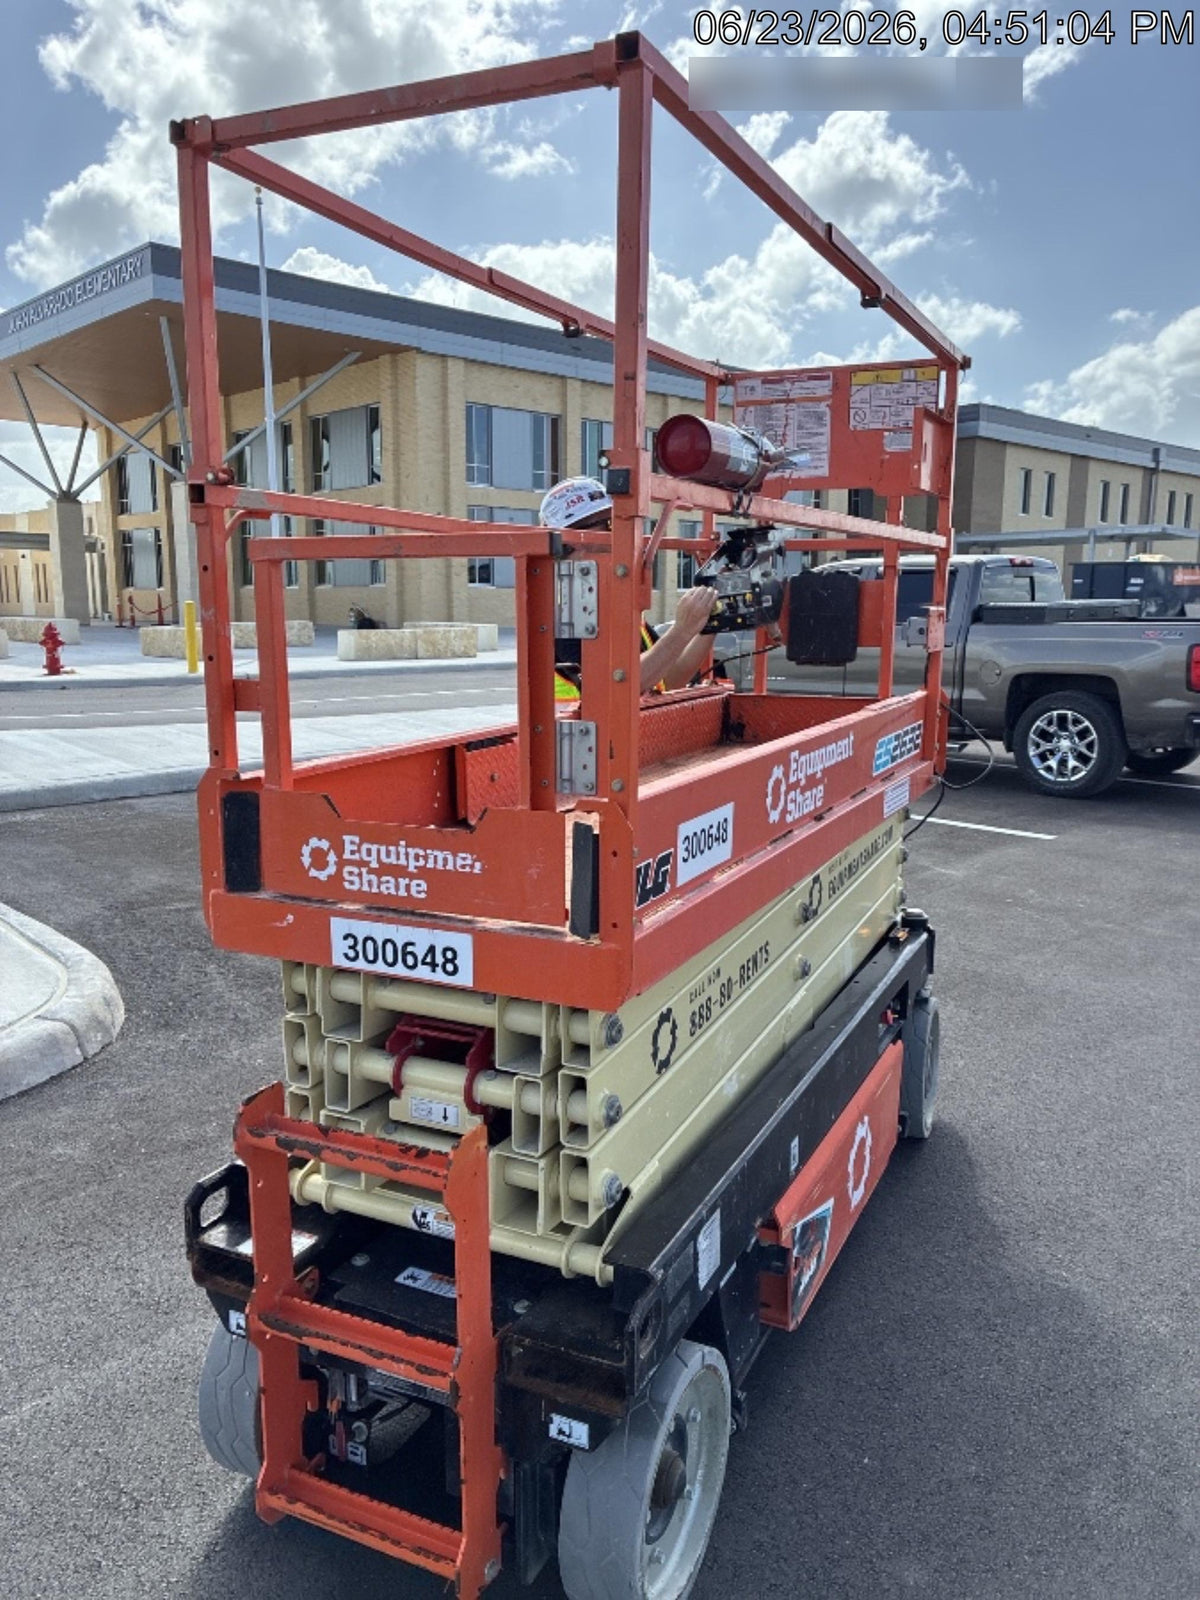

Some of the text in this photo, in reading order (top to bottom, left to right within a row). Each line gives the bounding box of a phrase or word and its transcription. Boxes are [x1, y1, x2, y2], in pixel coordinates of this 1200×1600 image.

[75, 254, 145, 303] ELEMENTARY
[788, 731, 854, 783] Equipment
[785, 782, 824, 823] Share
[681, 817, 729, 864] 300648
[342, 865, 428, 899] Share
[342, 933, 460, 977] 300648
